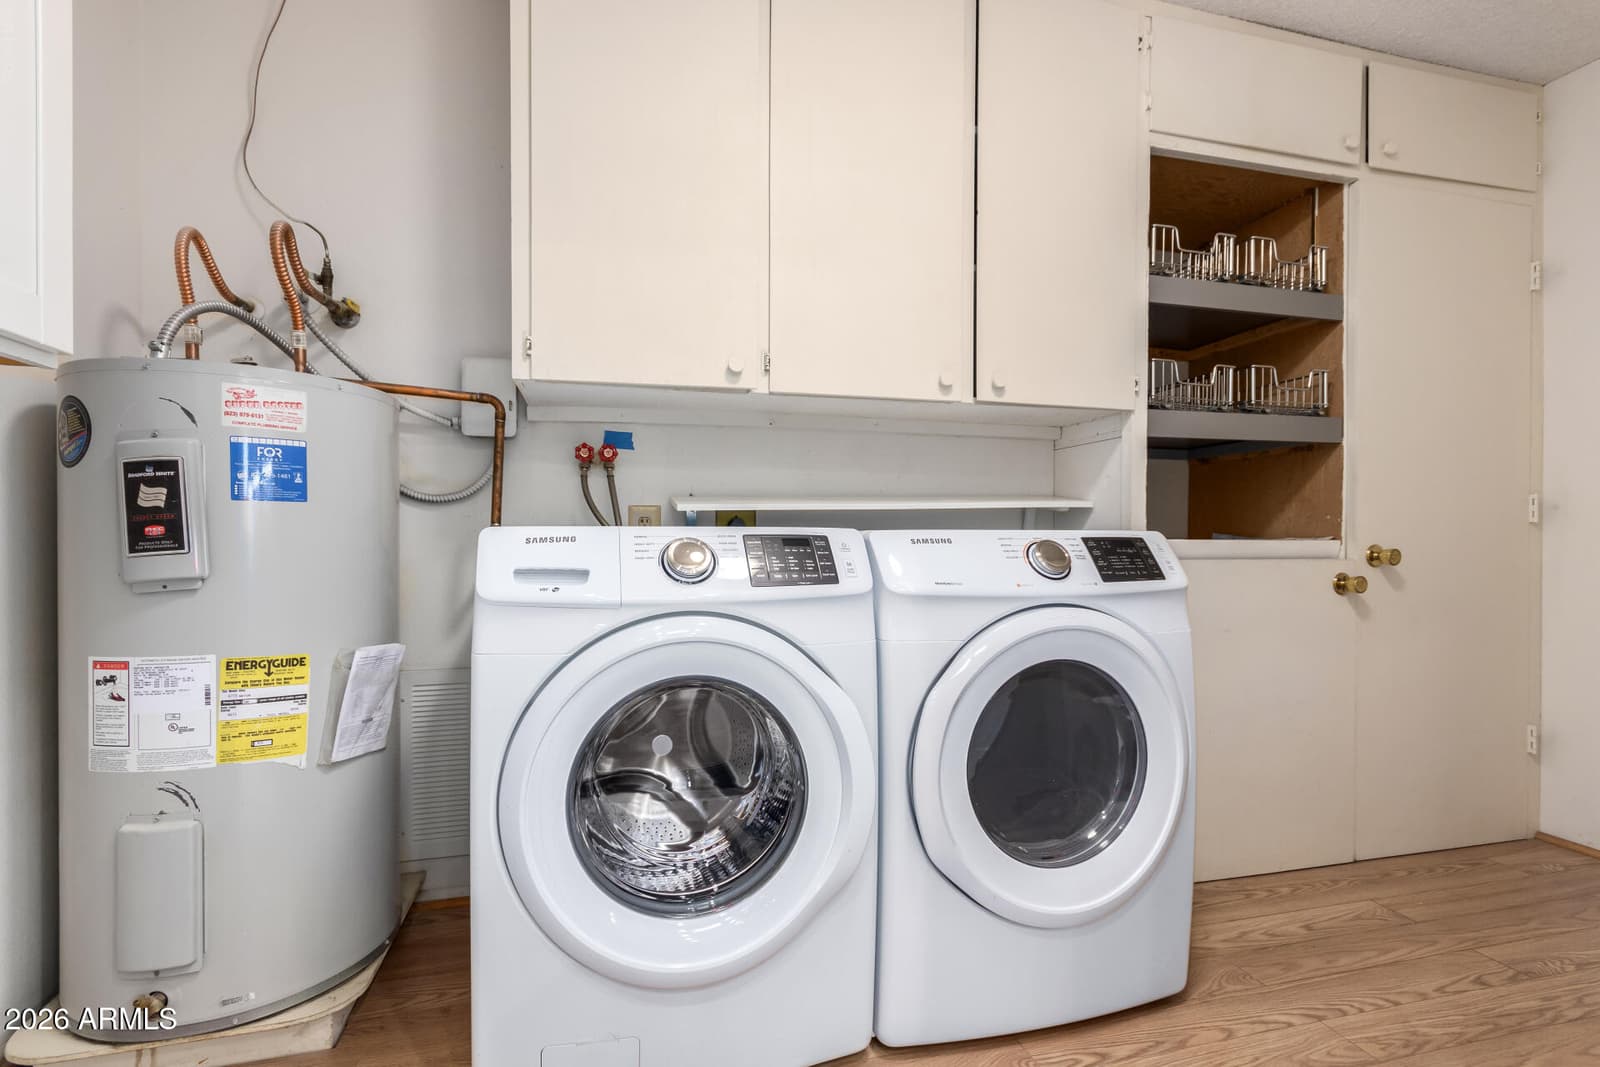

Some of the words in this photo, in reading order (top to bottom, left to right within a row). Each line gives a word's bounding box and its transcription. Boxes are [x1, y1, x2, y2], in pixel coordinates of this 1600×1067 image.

[256, 447, 282, 458] FOR
[525, 535, 577, 545] SAMSUNG
[910, 537, 953, 545] SAMSUNG
[225, 657, 306, 672] ENERGYGUIDE
